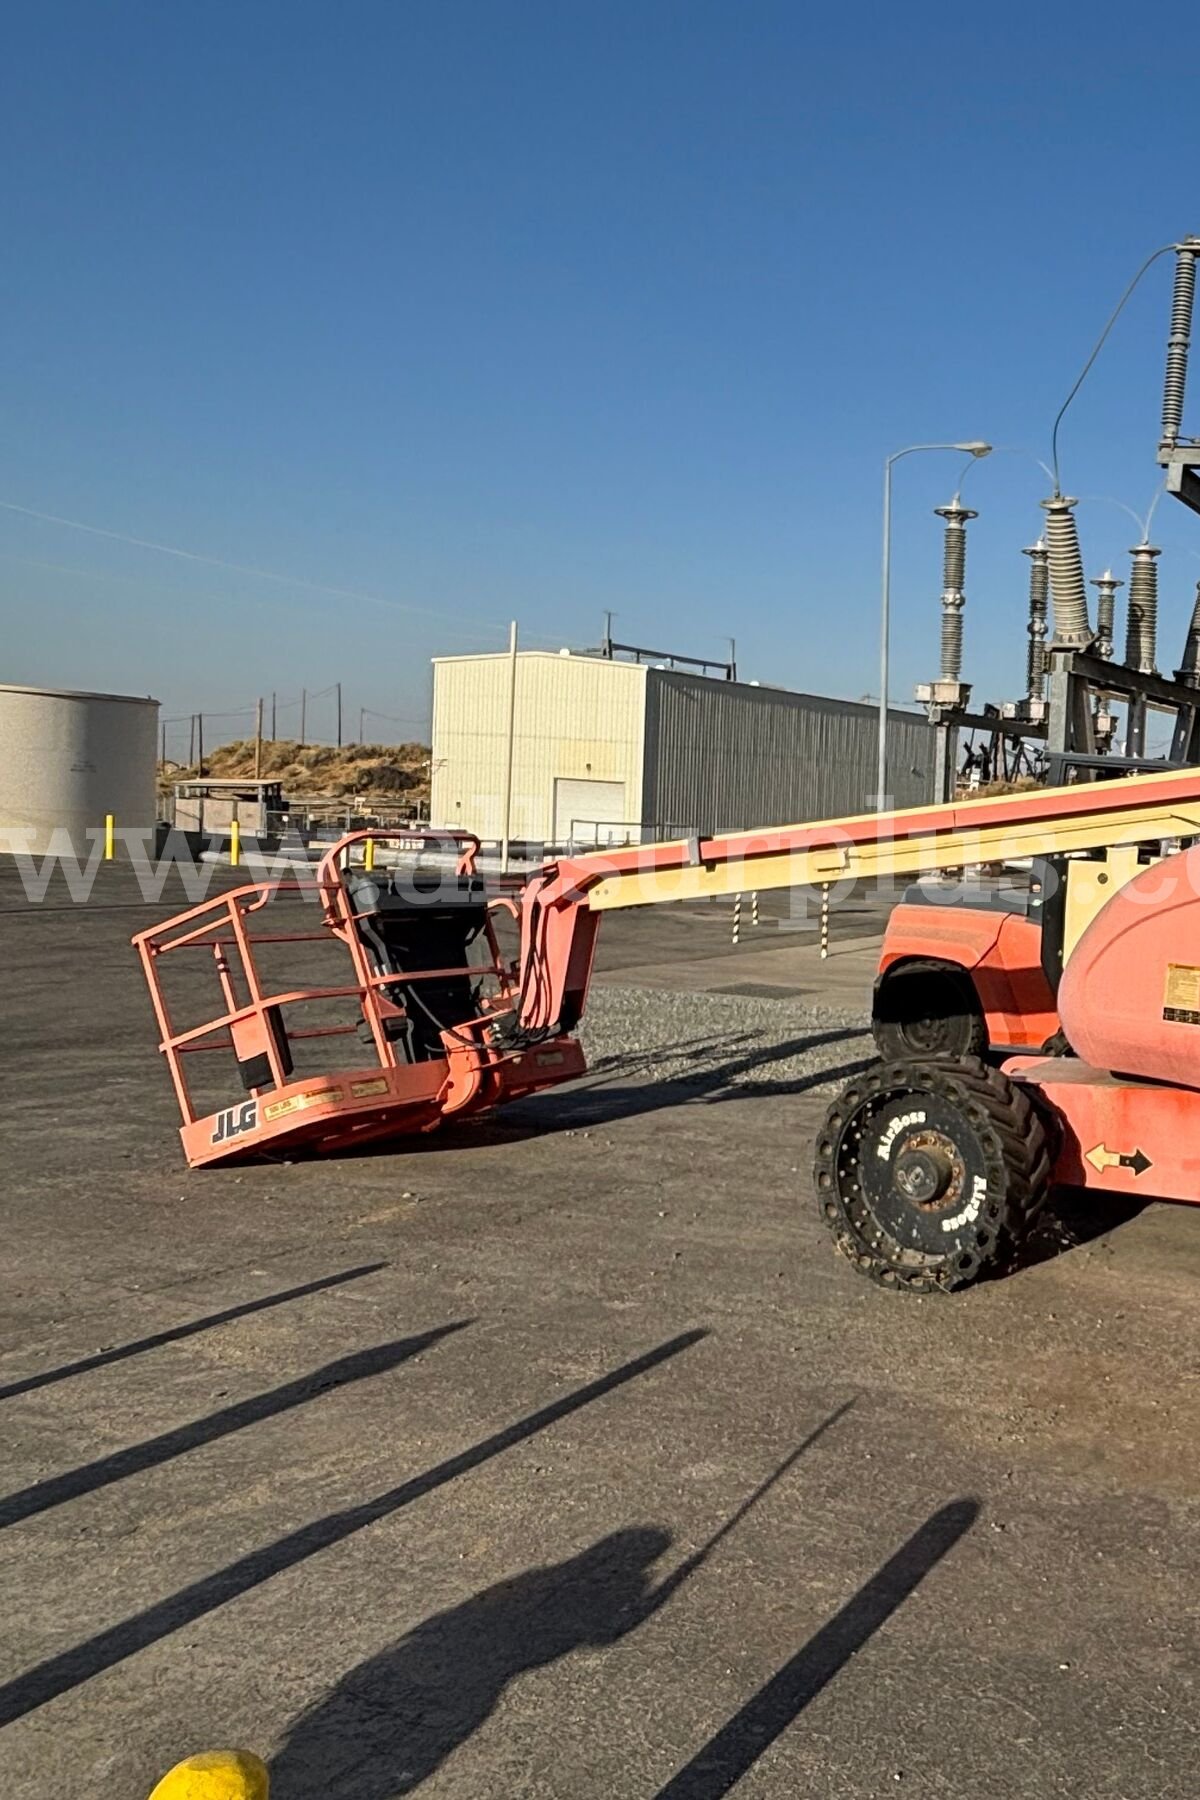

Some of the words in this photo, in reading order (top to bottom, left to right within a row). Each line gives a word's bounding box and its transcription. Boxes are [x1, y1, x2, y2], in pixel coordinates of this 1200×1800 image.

[211, 1101, 258, 1144] JLG
[877, 1111, 926, 1161] AirBoss
[942, 1175, 987, 1232] AirBoss
